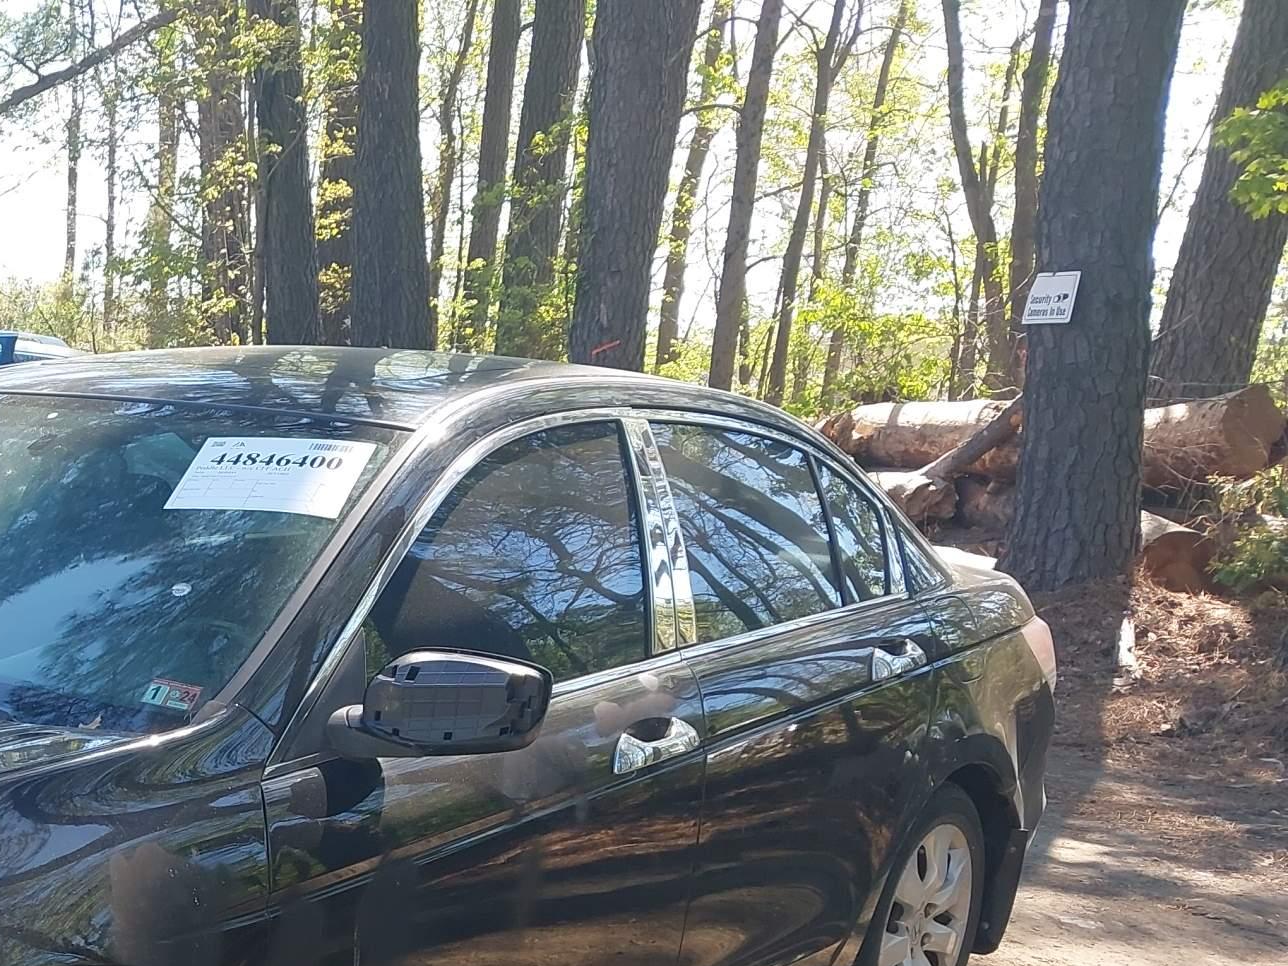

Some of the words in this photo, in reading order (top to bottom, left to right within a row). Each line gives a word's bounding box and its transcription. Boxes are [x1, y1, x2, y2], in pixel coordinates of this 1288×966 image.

[1030, 294, 1052, 305] Security
[1027, 306, 1049, 317] Cameras
[1056, 306, 1067, 316] Use
[210, 452, 344, 470] 44846400
[151, 685, 162, 700] 1
[180, 691, 197, 704] 24
